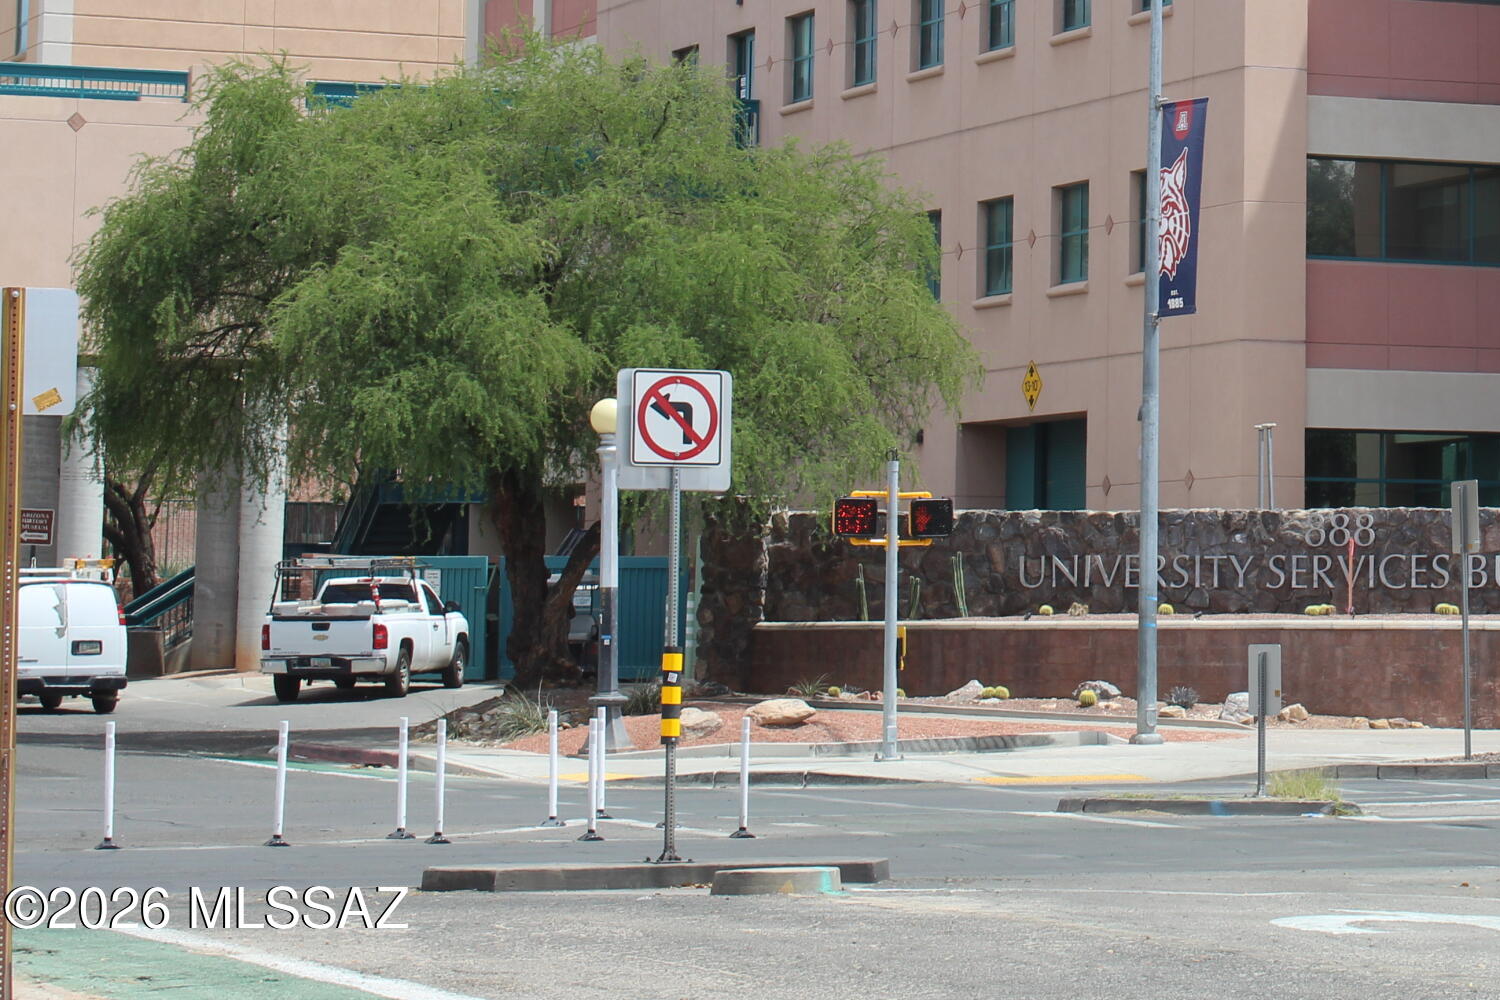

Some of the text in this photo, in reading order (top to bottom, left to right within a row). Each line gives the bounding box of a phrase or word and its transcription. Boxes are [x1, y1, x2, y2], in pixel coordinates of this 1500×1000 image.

[1304, 513, 1376, 547] 888
[1018, 554, 1254, 589] UNIVERSITY
[1266, 553, 1450, 589] SERVICES
